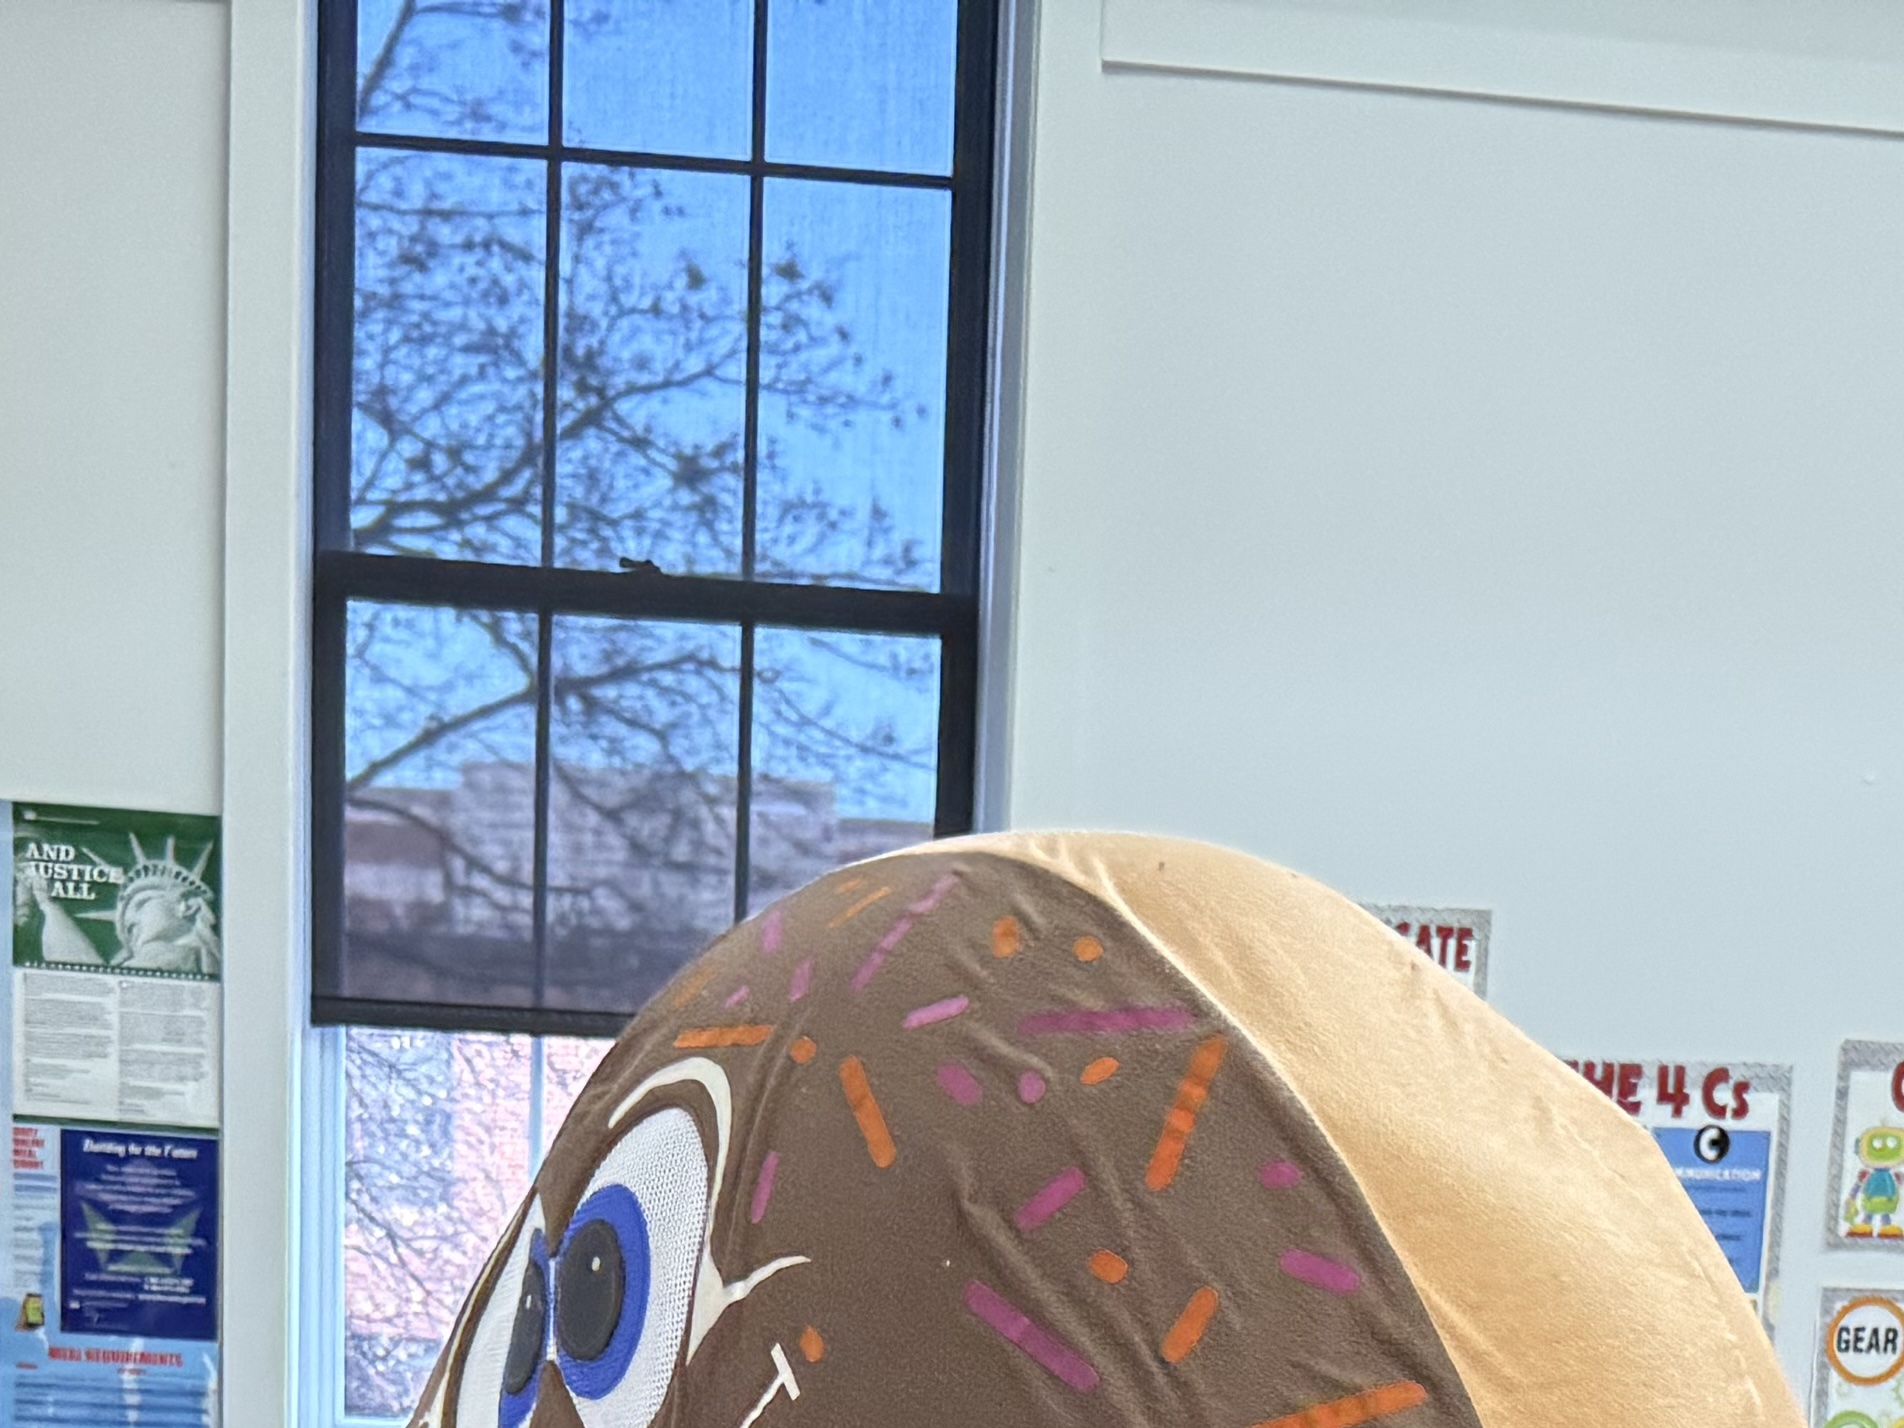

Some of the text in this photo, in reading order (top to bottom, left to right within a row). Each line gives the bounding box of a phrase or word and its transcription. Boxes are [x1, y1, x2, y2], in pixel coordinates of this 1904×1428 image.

[25, 842, 75, 861] AND
[30, 861, 126, 884] JUSTICE
[51, 881, 96, 900] ALL
[1564, 1060, 1642, 1117] HE
[1656, 1064, 1690, 1118] 4
[1836, 1326, 1899, 1355] GEAR
